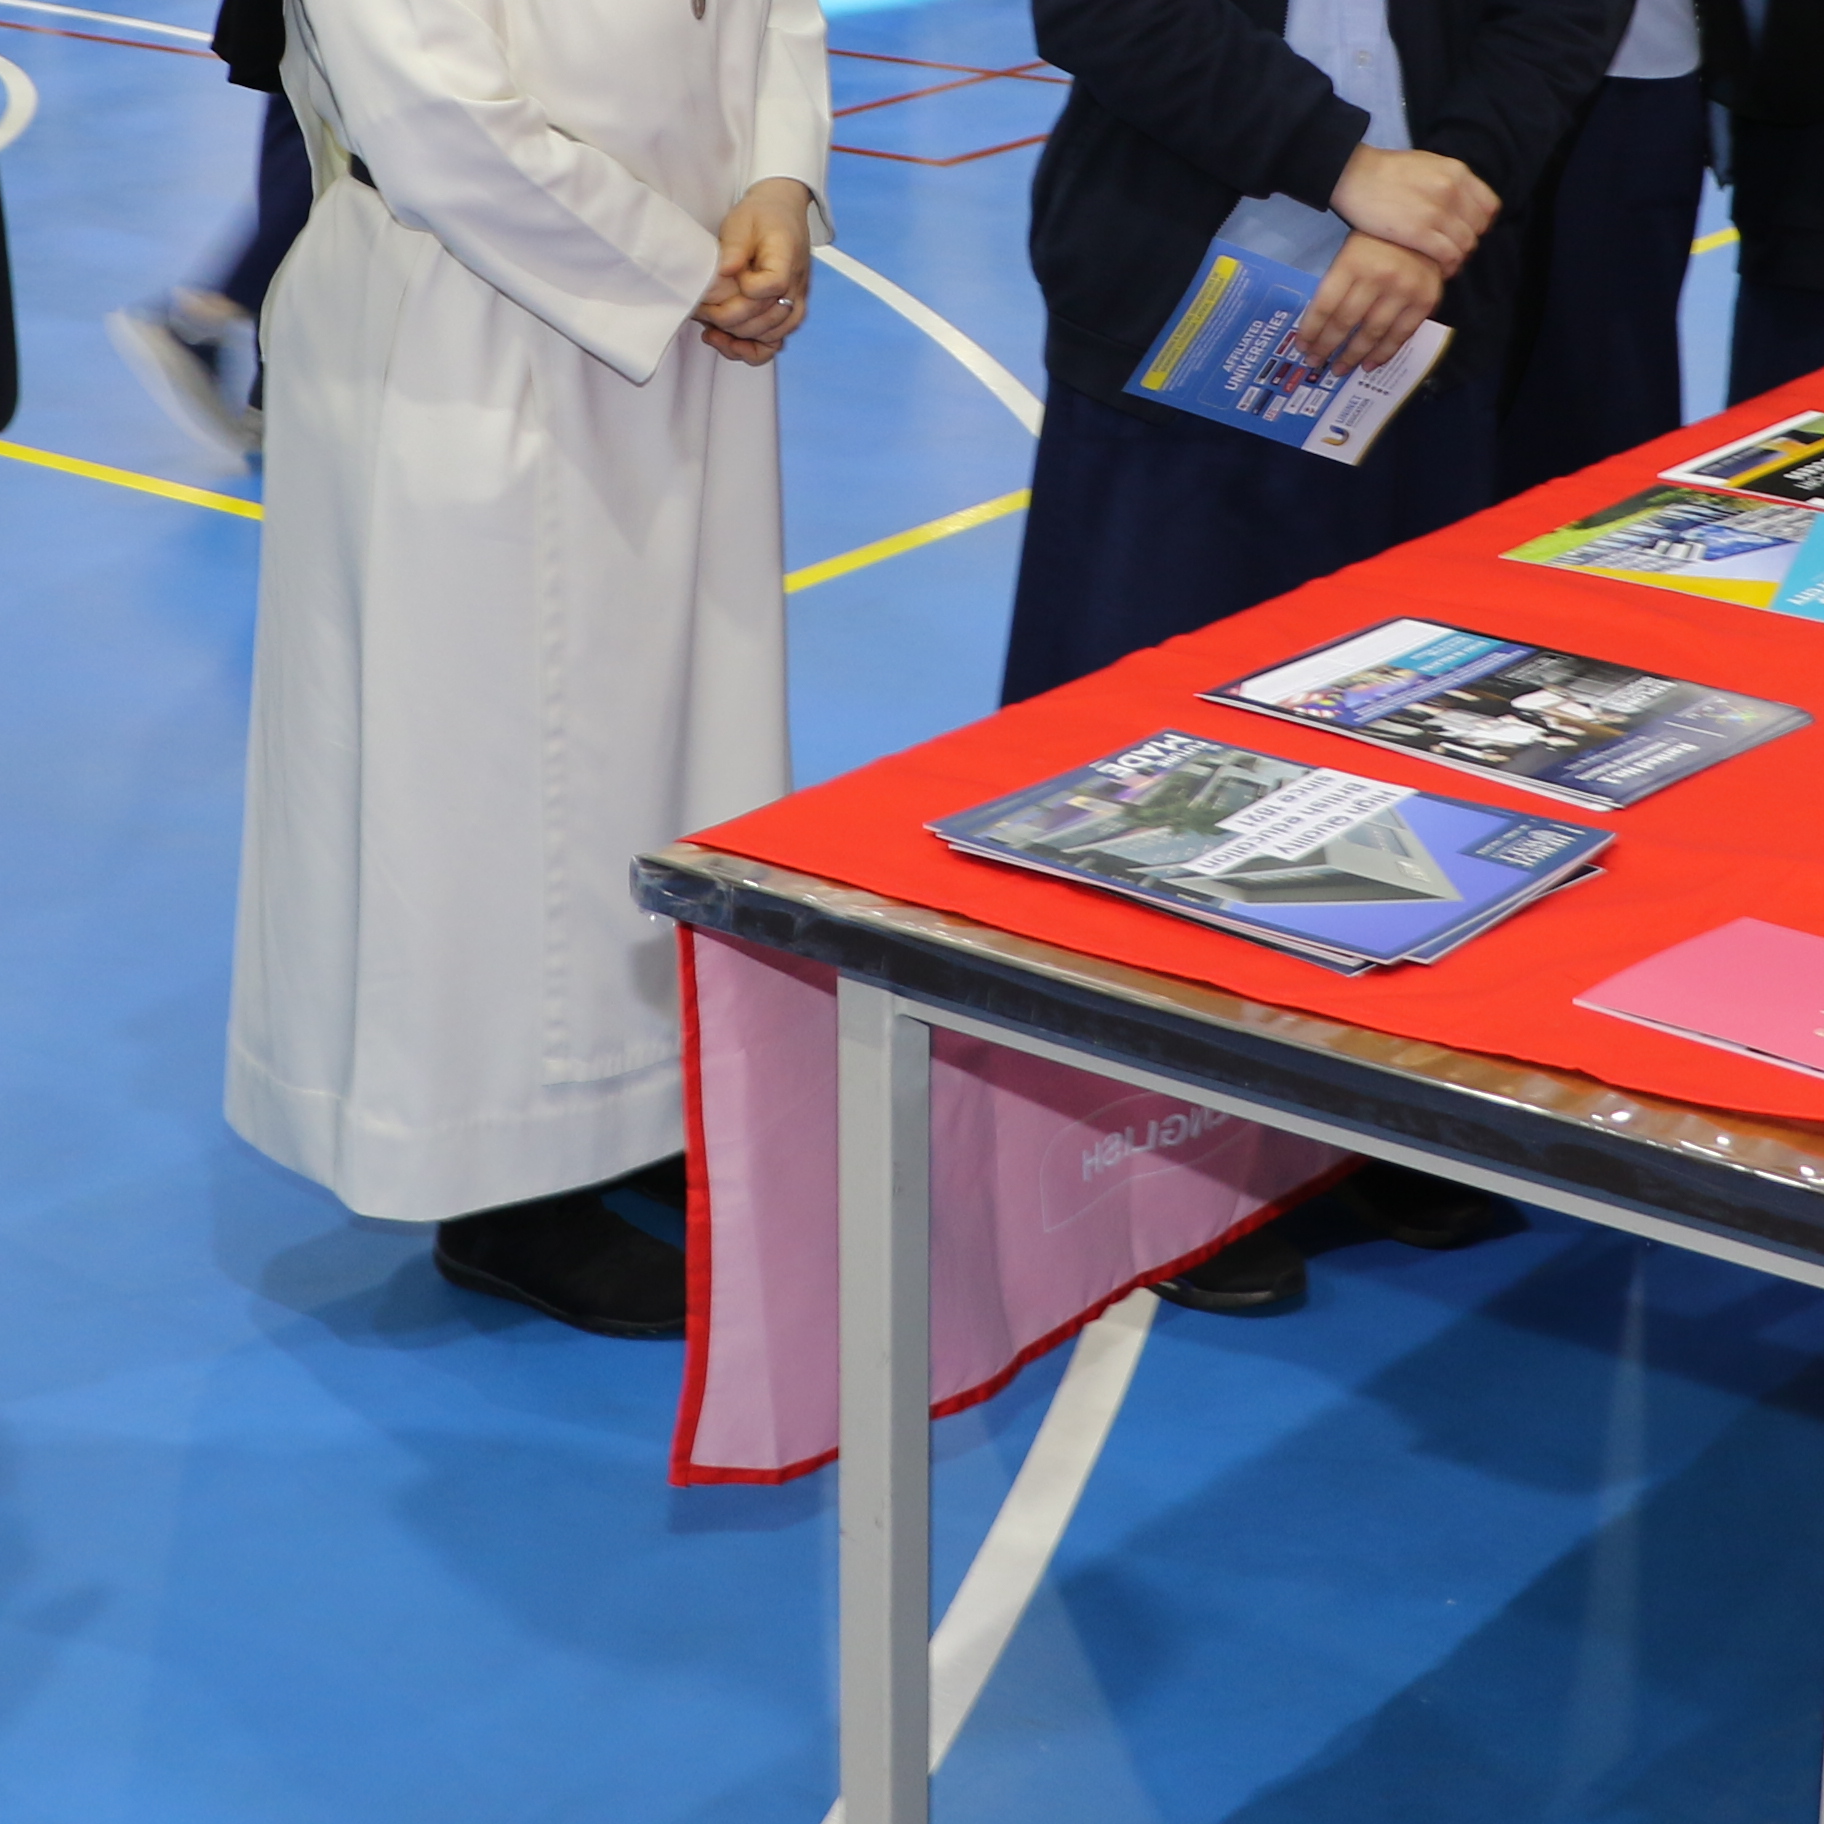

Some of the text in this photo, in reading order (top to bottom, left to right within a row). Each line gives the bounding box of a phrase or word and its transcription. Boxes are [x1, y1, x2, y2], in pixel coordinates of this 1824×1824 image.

[1223, 320, 1264, 373] AFFILIATED
[1225, 311, 1288, 391] UNIVERSITIES
[1334, 391, 1361, 426] UNINET
[1099, 734, 1191, 779] MADE
[1597, 765, 1645, 785] No.1
[1634, 742, 1699, 770] Ranked
[1196, 782, 1369, 869] British education
[1236, 775, 1335, 827] since 1821
[1277, 789, 1398, 855] High Quality
